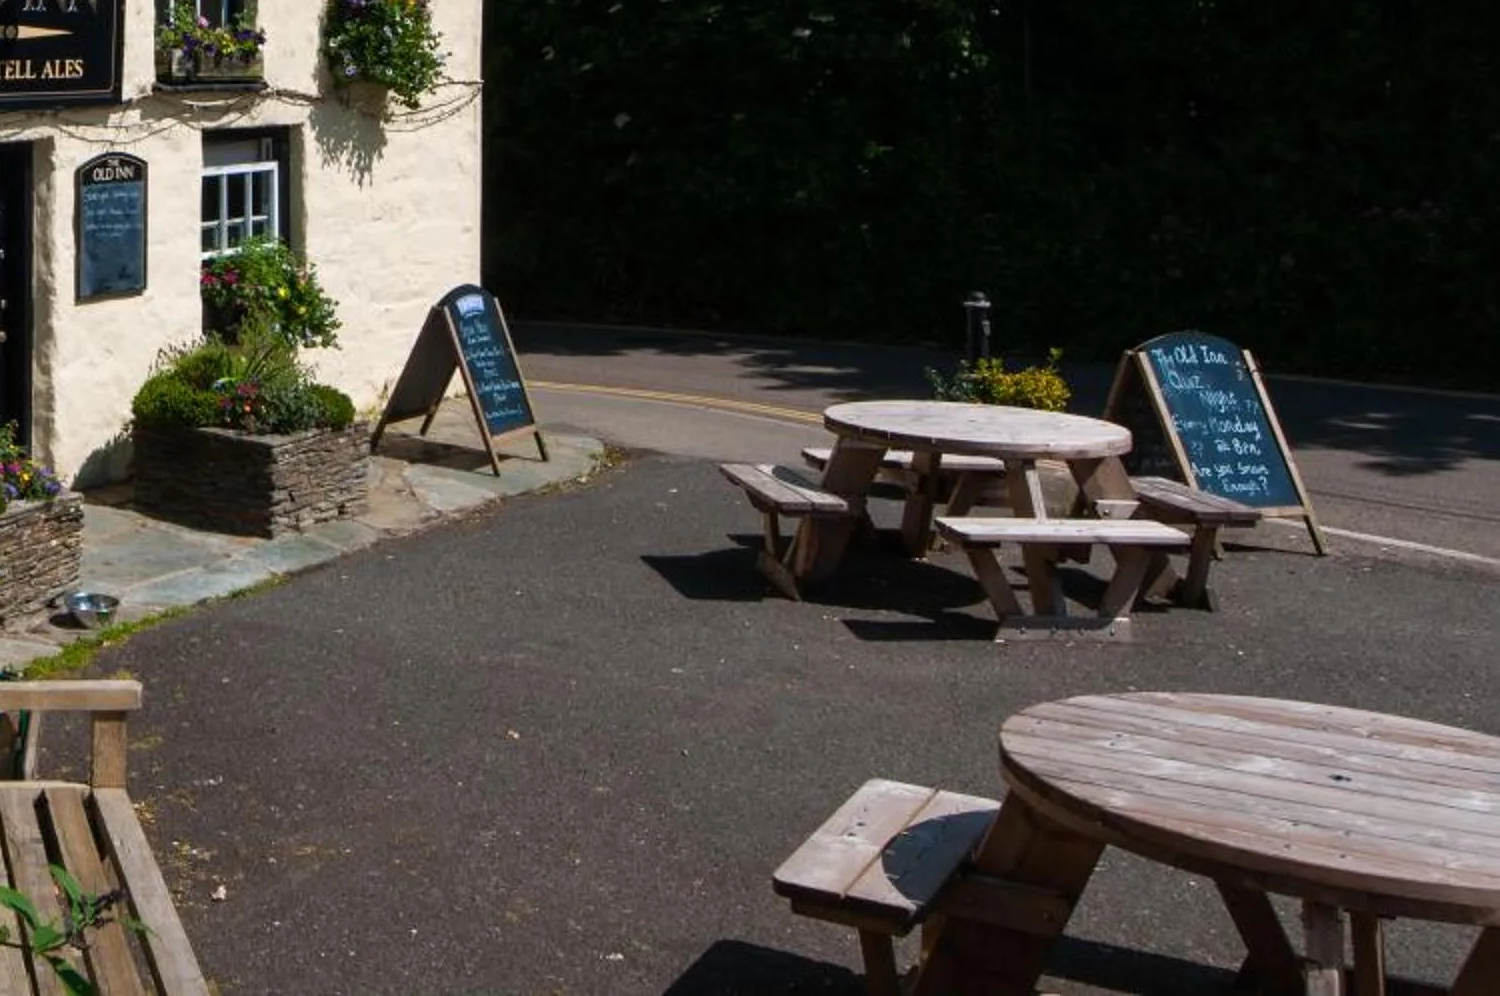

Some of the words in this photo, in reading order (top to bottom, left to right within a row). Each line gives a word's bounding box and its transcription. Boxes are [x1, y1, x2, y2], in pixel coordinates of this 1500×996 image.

[41, 58, 84, 78] ALES
[93, 167, 114, 181] OLD
[115, 166, 134, 179] INN
[1176, 344, 1199, 364] Old
[1200, 345, 1229, 365] Inn
[1209, 414, 1261, 442] Monday
[1213, 463, 1234, 479] you
